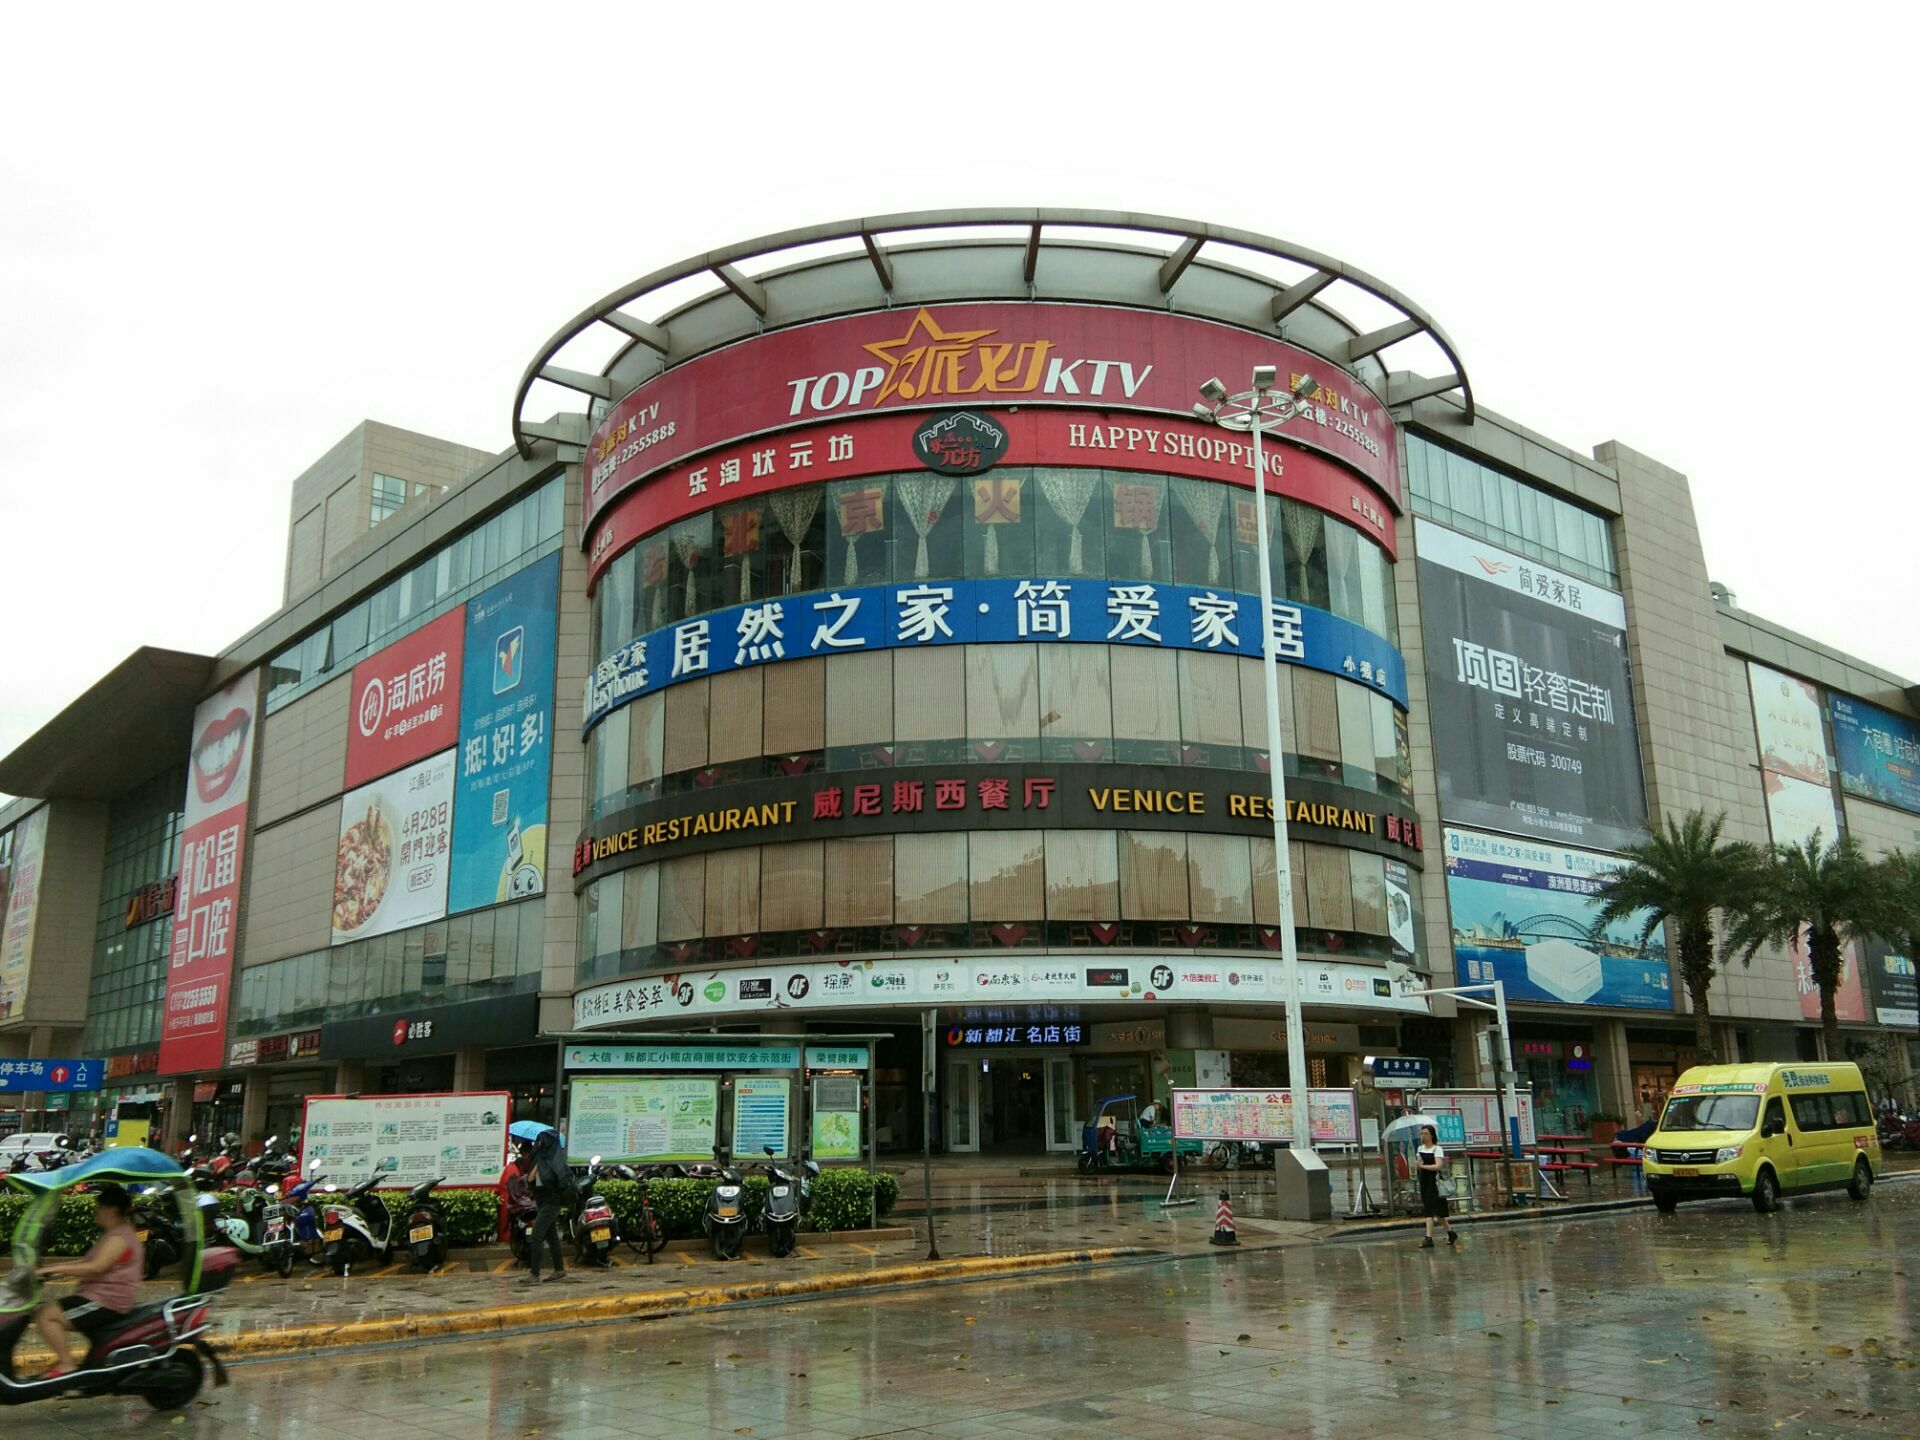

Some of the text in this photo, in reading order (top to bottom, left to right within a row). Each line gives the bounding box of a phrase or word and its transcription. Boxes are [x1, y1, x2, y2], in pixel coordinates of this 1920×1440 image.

[788, 365, 885, 416] TOP
[1043, 358, 1154, 398] KTV
[688, 433, 855, 497] 乐淘状元坊
[1069, 423, 1285, 477] HAPPY SHOPPING
[1518, 564, 1582, 611] 简爱家居
[386, 652, 447, 718] 海底捞
[1453, 637, 1615, 726] 顶固 轻奢定制
[492, 723, 516, 767] 好!
[520, 710, 545, 757] 多!
[1494, 702, 1588, 742] 定义高端定制
[1507, 742, 1582, 775] 股票代码 300749
[402, 801, 448, 838] 4月28日
[812, 777, 1056, 821] 威尼斯西餐厅
[1089, 787, 1376, 834] VENICE RESTAURANT
[592, 801, 797, 861] VENICE RESTAURANT
[193, 824, 239, 898] 松鼠
[187, 896, 232, 963] 口腔
[789, 978, 807, 996] 4F
[1152, 969, 1172, 987] 5F
[408, 1020, 432, 1039] 必胜客
[965, 1026, 1082, 1044] 新都汇 名店街
[0, 1062, 44, 1076] 停车场
[76, 1063, 88, 1082] 入口
